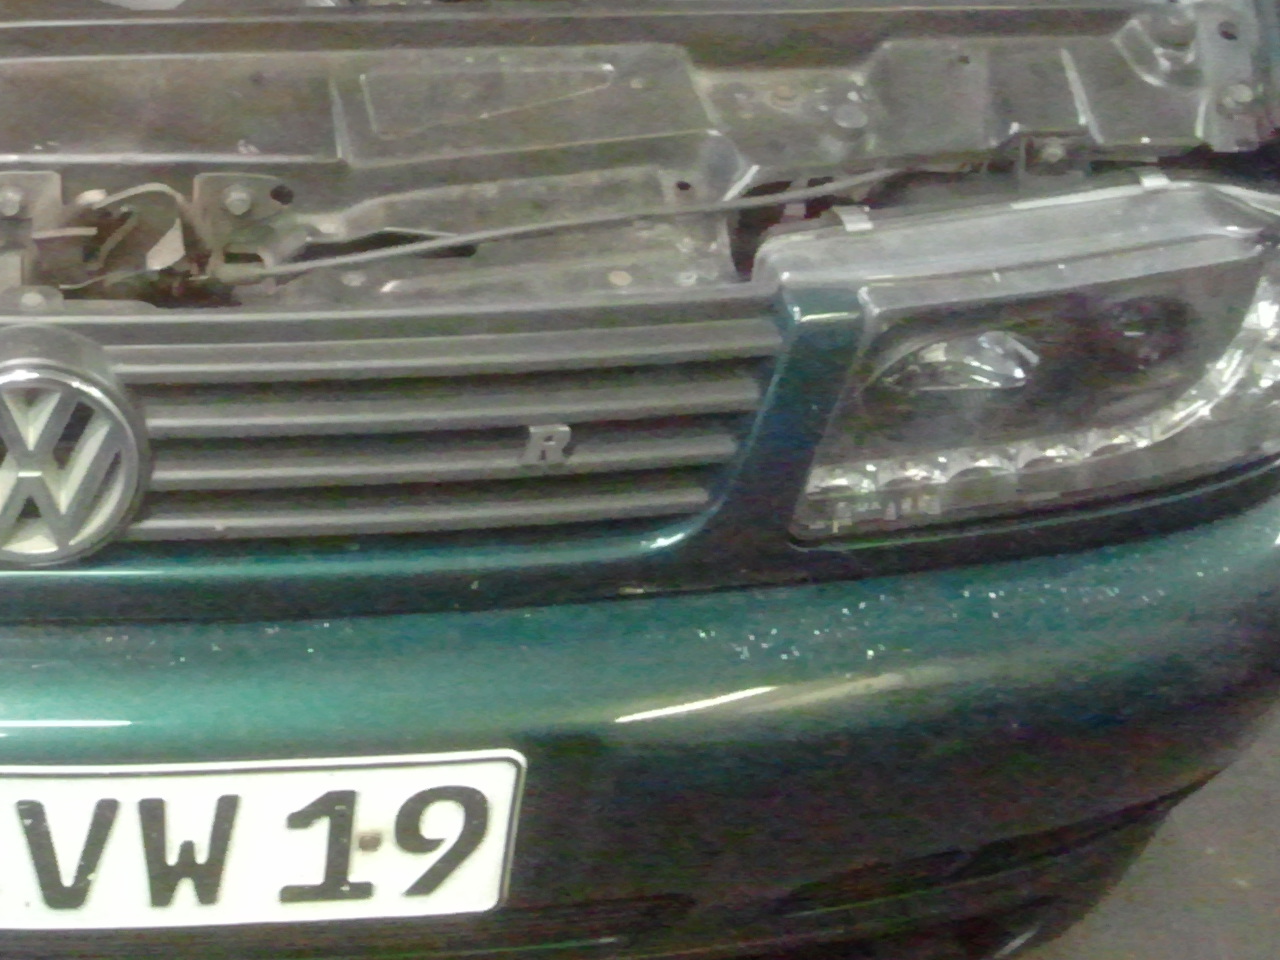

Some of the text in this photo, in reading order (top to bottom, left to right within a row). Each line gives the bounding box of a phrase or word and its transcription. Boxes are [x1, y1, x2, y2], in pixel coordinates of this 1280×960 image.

[522, 424, 571, 464] R
[16, 794, 240, 910] VW
[278, 785, 490, 903] 19
